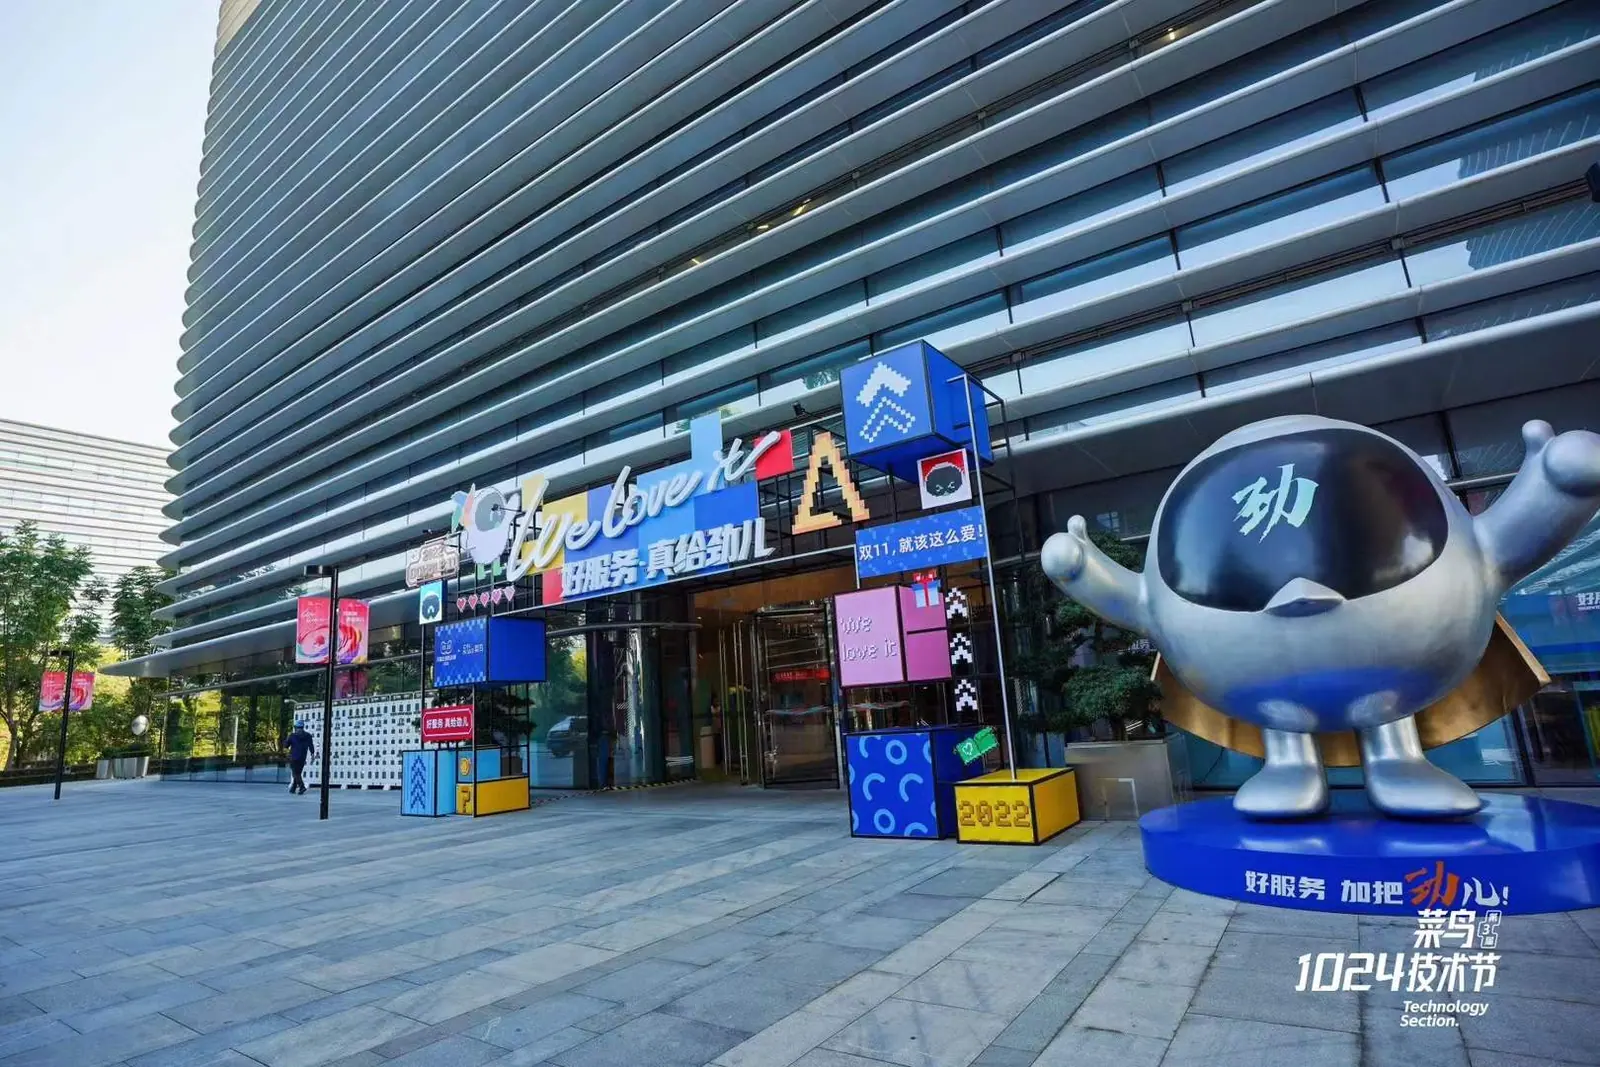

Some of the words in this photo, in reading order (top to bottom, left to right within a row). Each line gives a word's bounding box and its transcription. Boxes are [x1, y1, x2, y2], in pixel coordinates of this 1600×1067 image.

[602, 465, 703, 539] love
[707, 431, 782, 493] it
[1231, 463, 1319, 544] 劲
[959, 800, 1031, 828] 2022
[1245, 870, 1326, 901] 好服务
